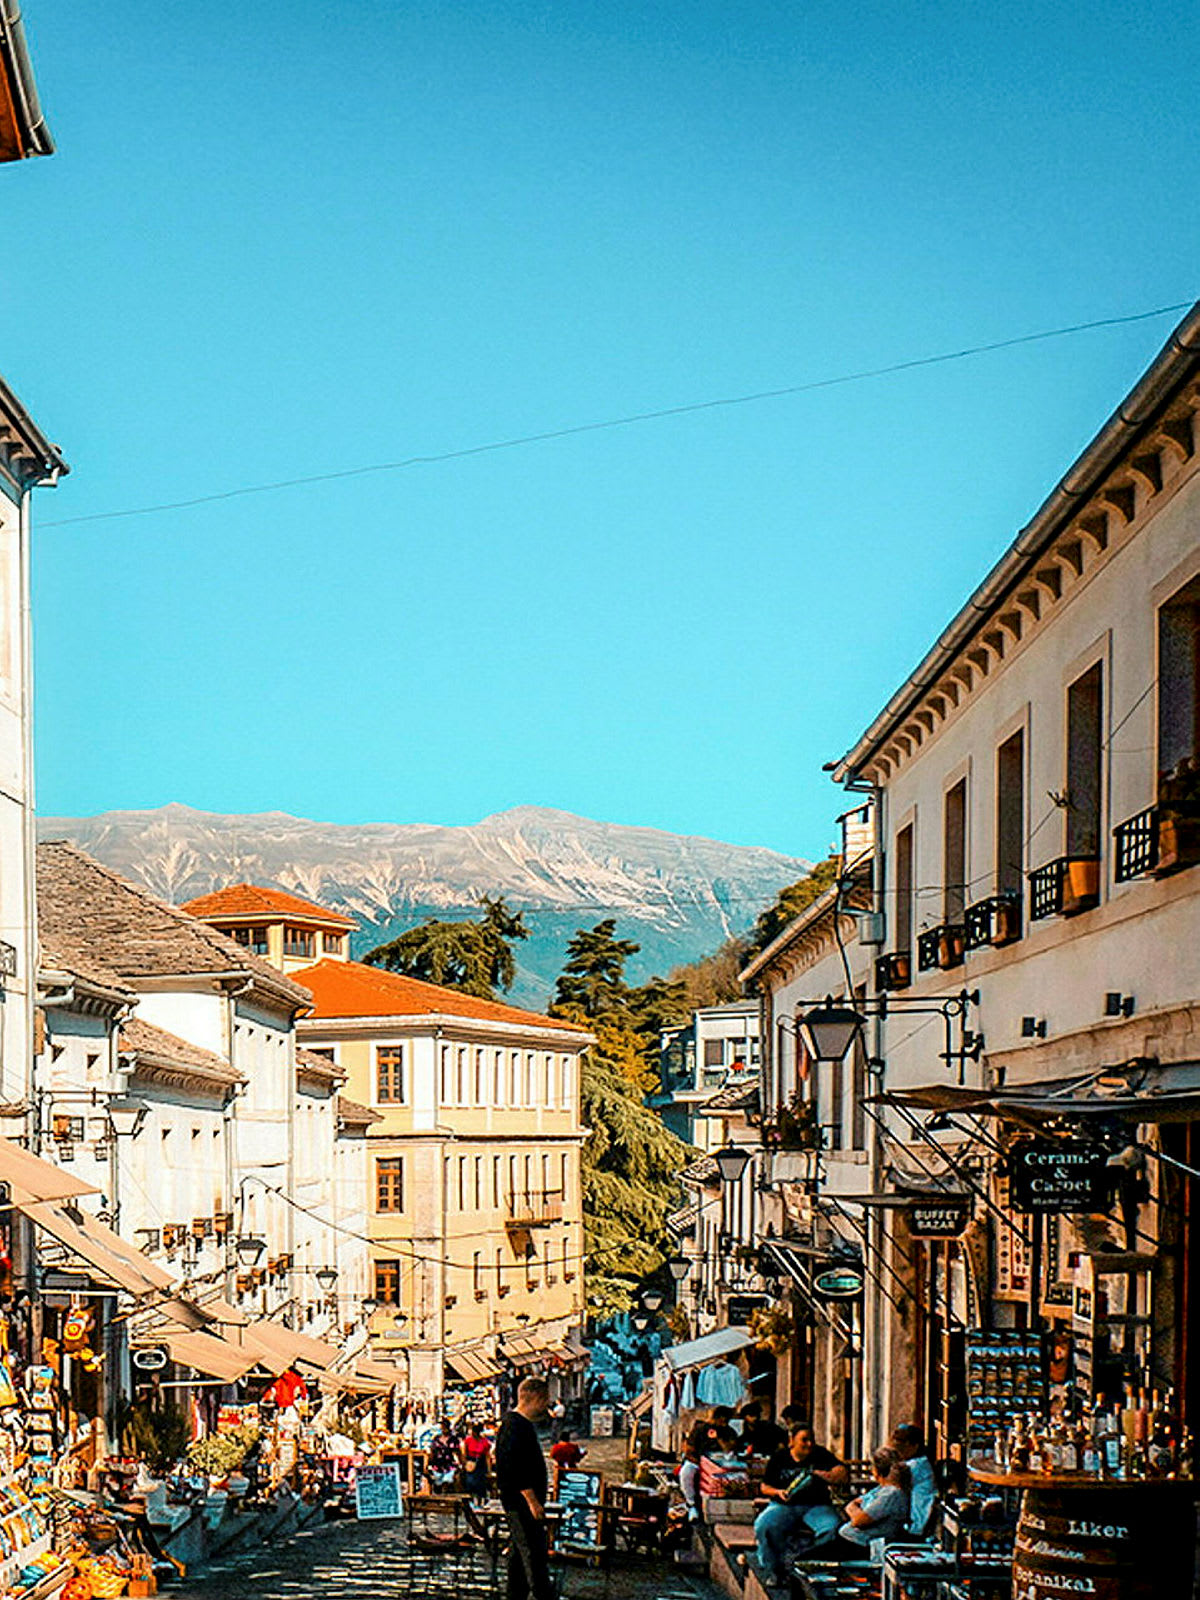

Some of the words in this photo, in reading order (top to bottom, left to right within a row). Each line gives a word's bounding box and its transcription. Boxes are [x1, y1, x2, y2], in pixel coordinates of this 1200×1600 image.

[1053, 1166, 1069, 1179] &
[914, 1209, 960, 1221] BUFFET
[1067, 1519, 1129, 1539] Liker
